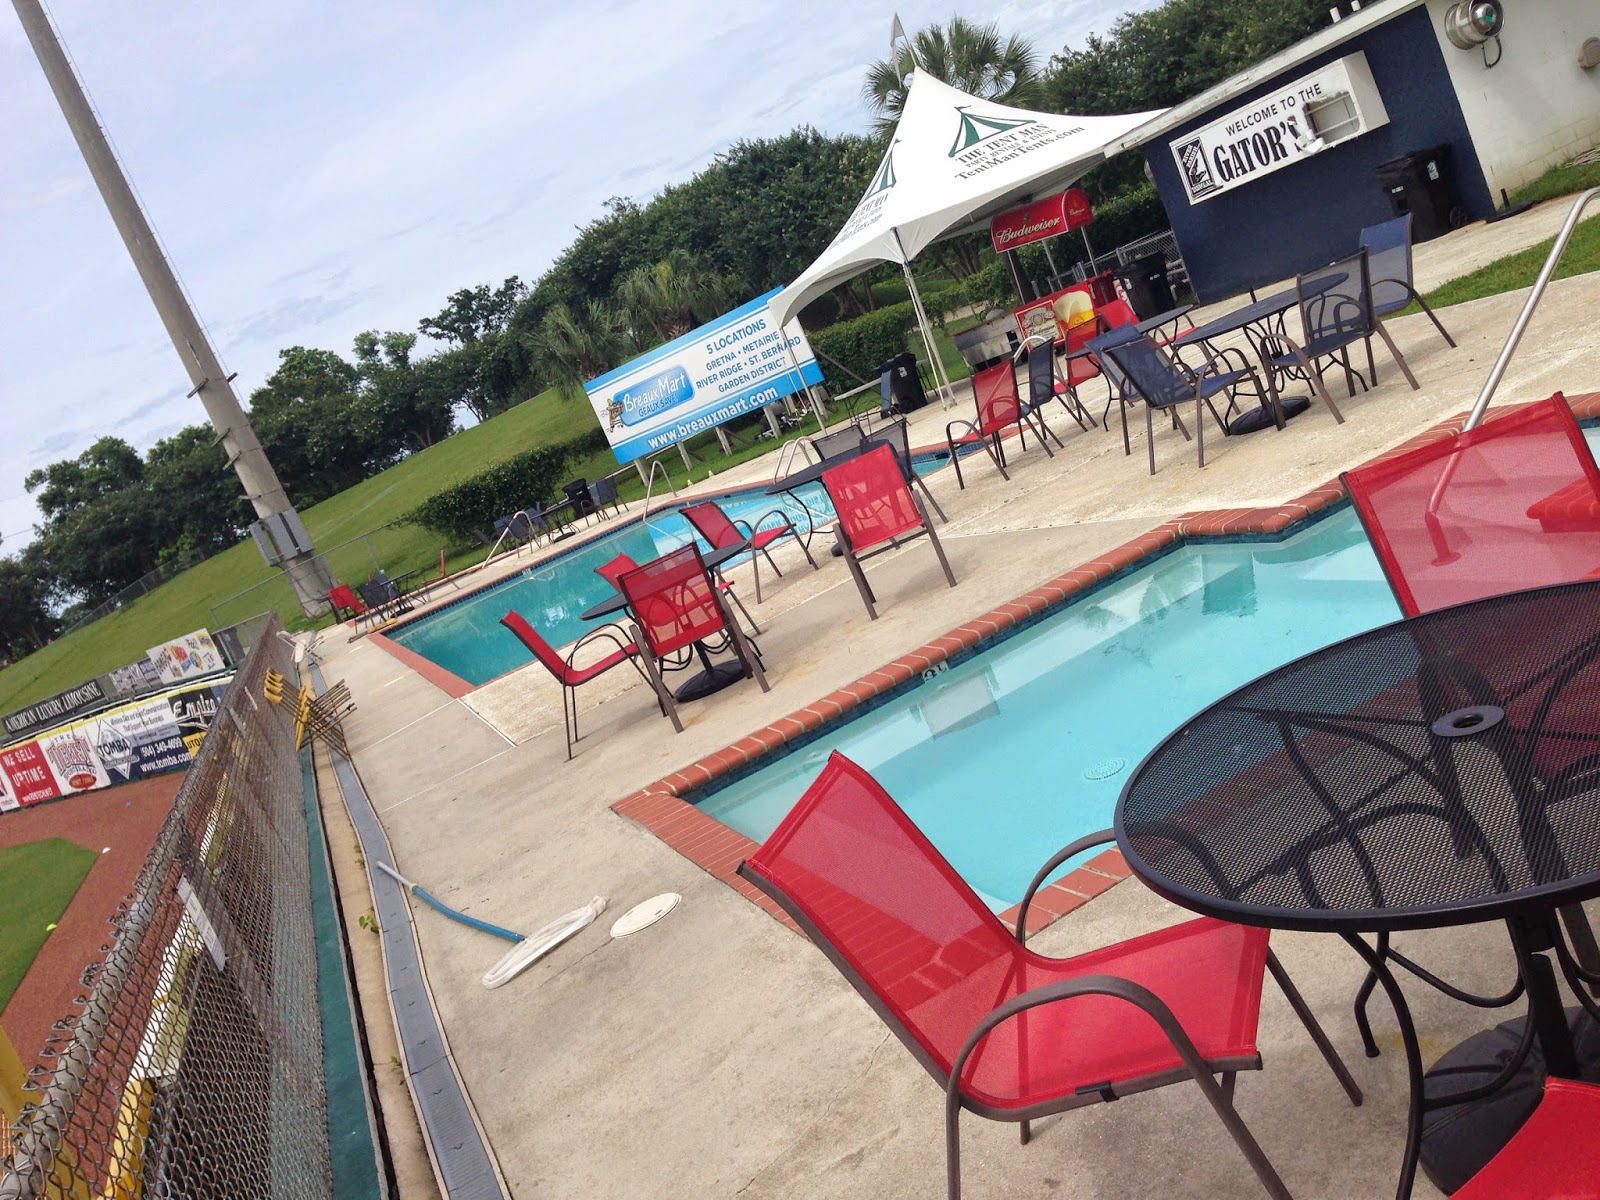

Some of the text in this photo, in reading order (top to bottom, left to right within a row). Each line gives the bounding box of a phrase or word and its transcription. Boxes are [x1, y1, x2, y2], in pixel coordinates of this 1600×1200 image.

[1225, 83, 1322, 136] WELCOME TO THE
[954, 125, 1086, 180] TentManTents.com
[955, 123, 1050, 164] THE TENT MAN
[995, 216, 1061, 245] Budweiser
[705, 330, 780, 372] GRETNA METAIRIE
[706, 318, 767, 354] 5 LOCATIONS
[695, 335, 801, 390] RIVER RIDGE ST. BERNARD
[718, 356, 786, 393] GARDEN DISTRICT
[637, 401, 661, 417] GEAUX
[647, 385, 779, 450] www.breauxmart.com
[35, 698, 65, 721] LUXURY
[61, 681, 102, 711] LIMOUSINE
[2, 747, 36, 767] WE SELL
[98, 738, 130, 757] TOMBA
[140, 752, 193, 772] www.tomba.com
[12, 765, 46, 787] UPTIME
